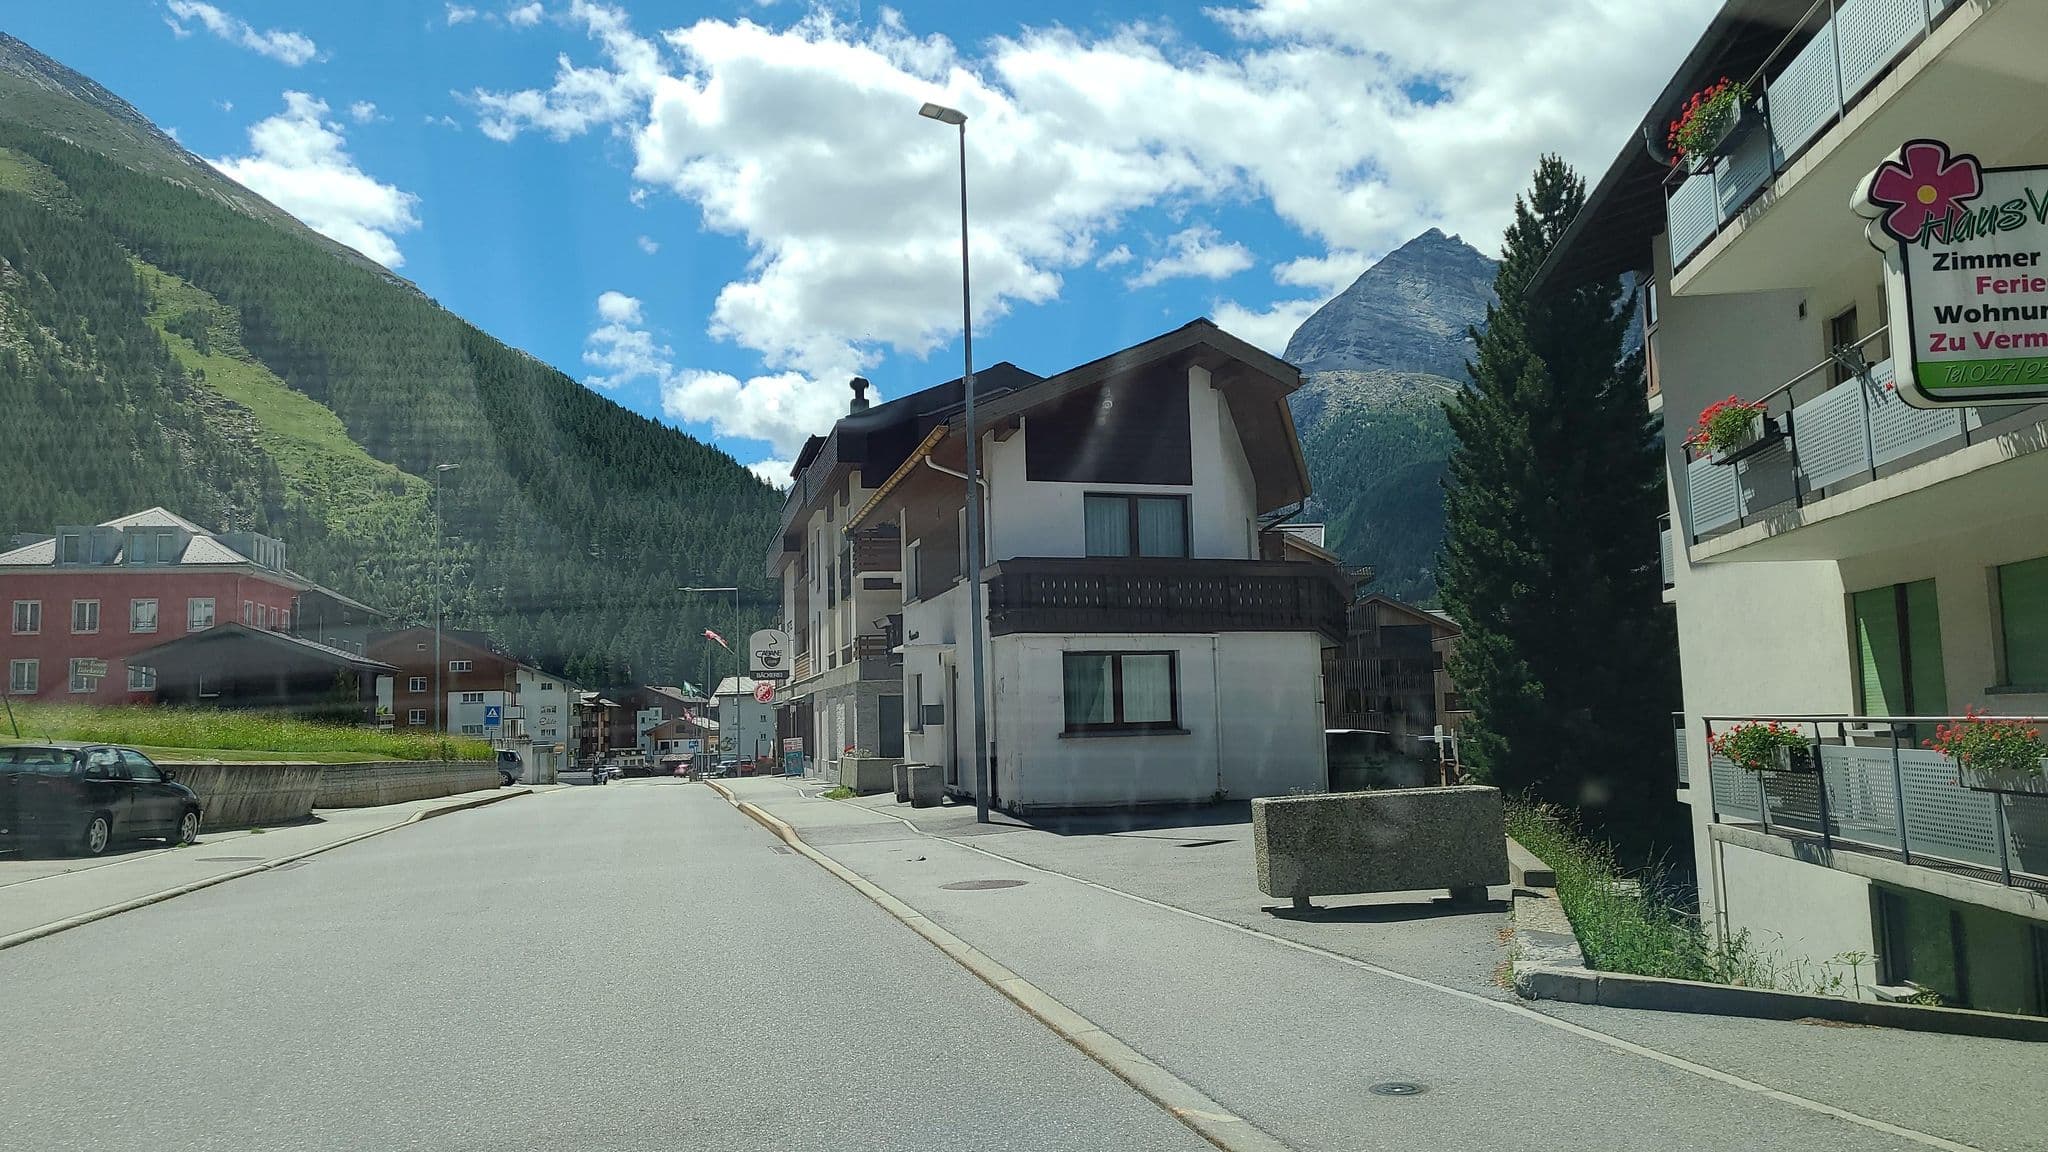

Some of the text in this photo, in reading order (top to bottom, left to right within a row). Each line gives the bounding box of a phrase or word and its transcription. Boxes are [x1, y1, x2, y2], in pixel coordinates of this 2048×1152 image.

[1921, 199, 2027, 249] Haus
[1932, 251, 2041, 271] Zimmer
[1929, 331, 2048, 352] Zu Verm
